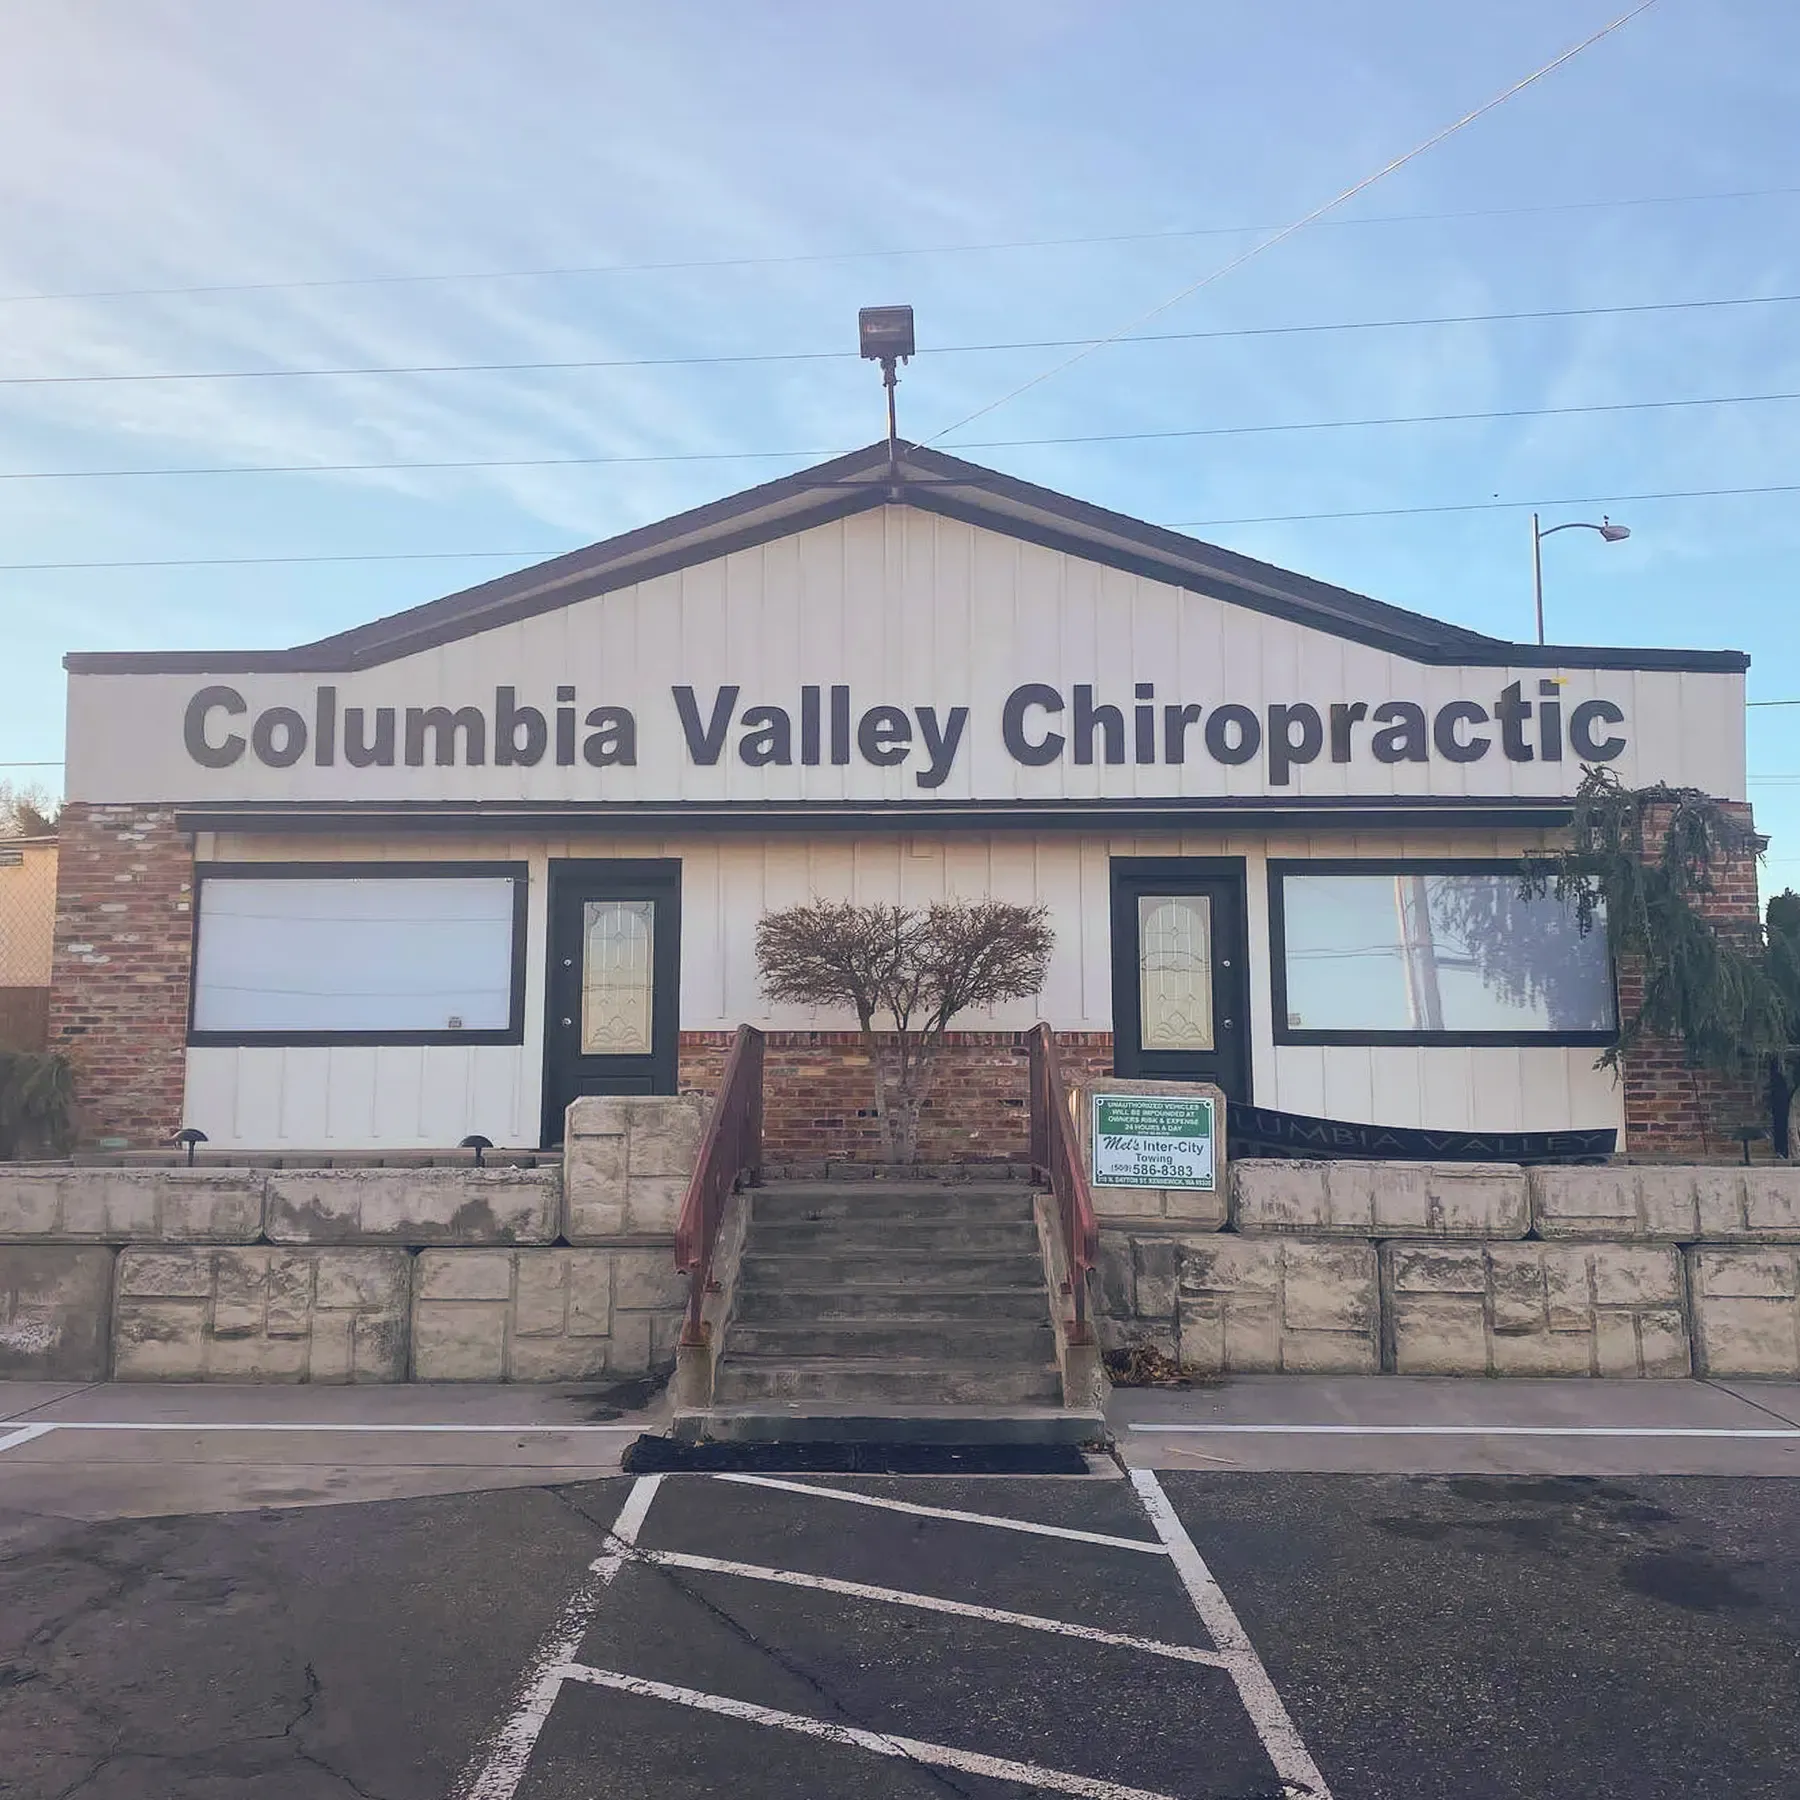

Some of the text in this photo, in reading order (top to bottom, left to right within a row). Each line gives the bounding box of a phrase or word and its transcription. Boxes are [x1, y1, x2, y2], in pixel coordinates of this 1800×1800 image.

[183, 678, 1626, 789] Columbia Valley Chiropractic
[1107, 1101, 1199, 1111] UNAUTHORIZED VEHICLES
[1234, 1108, 1601, 1153] LUMBIA VALLEY
[1103, 1136, 1204, 1155] Mel's Inter-City
[1136, 1153, 1173, 1165] Towing
[1111, 1164, 1193, 1177] (509) 586-8383
